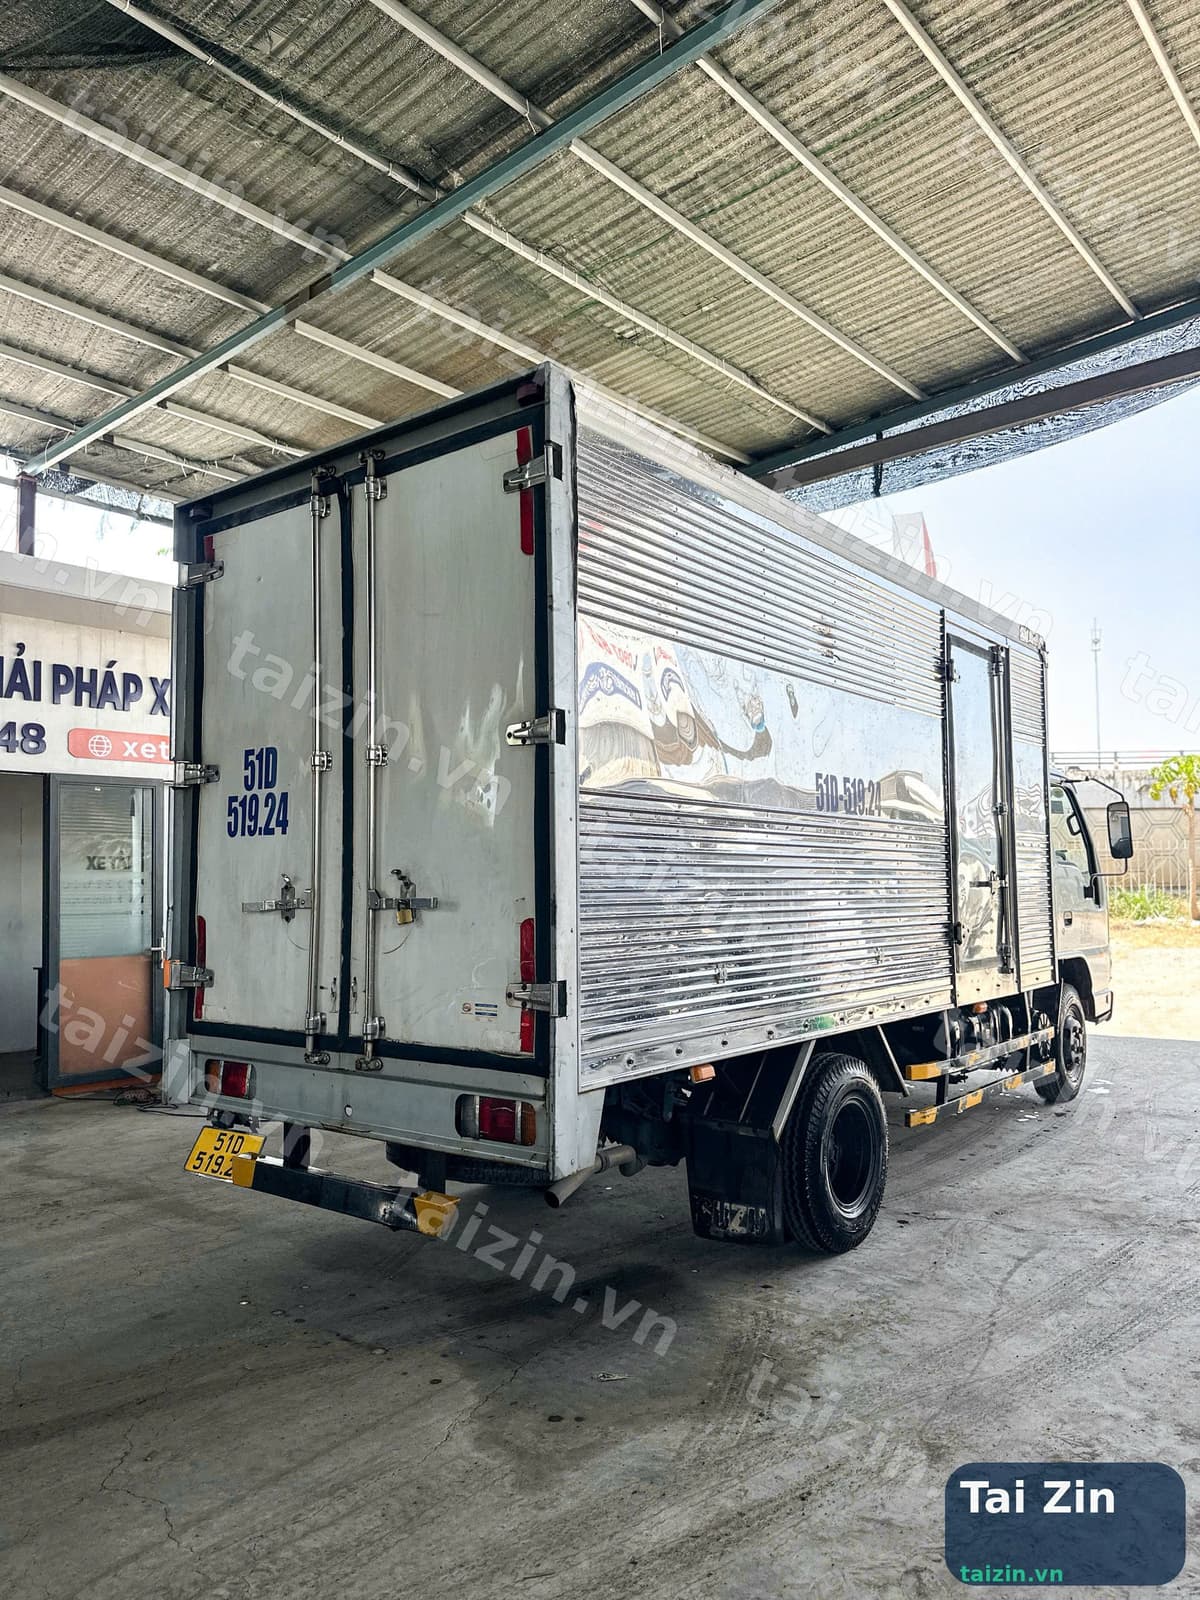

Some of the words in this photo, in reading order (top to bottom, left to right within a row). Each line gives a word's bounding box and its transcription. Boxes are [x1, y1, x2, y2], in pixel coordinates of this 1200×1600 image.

[52, 660, 144, 711] PHÁP
[244, 747, 278, 791] 51D
[227, 792, 289, 838] 519.24
[815, 772, 881, 817] 51D-519.24
[214, 1133, 245, 1154] 51D
